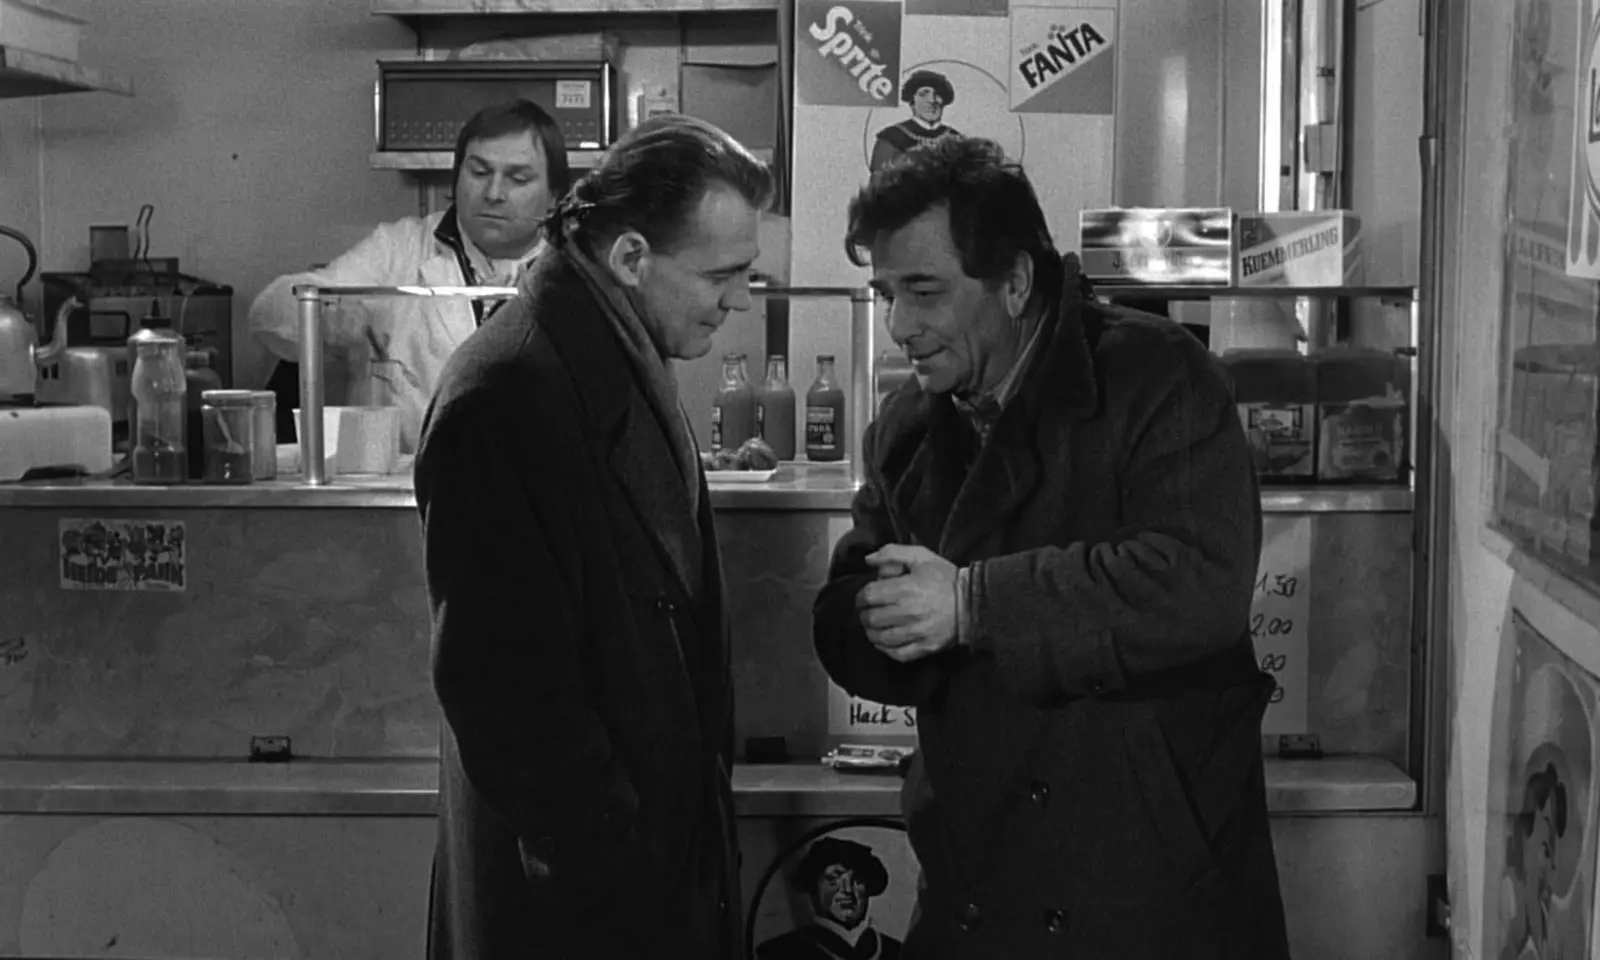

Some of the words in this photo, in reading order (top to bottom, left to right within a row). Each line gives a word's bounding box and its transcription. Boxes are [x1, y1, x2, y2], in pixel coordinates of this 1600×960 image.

[809, 6, 892, 100] Sprite
[1019, 22, 1106, 89] FANTA
[1250, 613, 1294, 637] 2.00
[1261, 653, 1287, 672] 00
[849, 703, 896, 728] Hack
[903, 707, 915, 728] S
